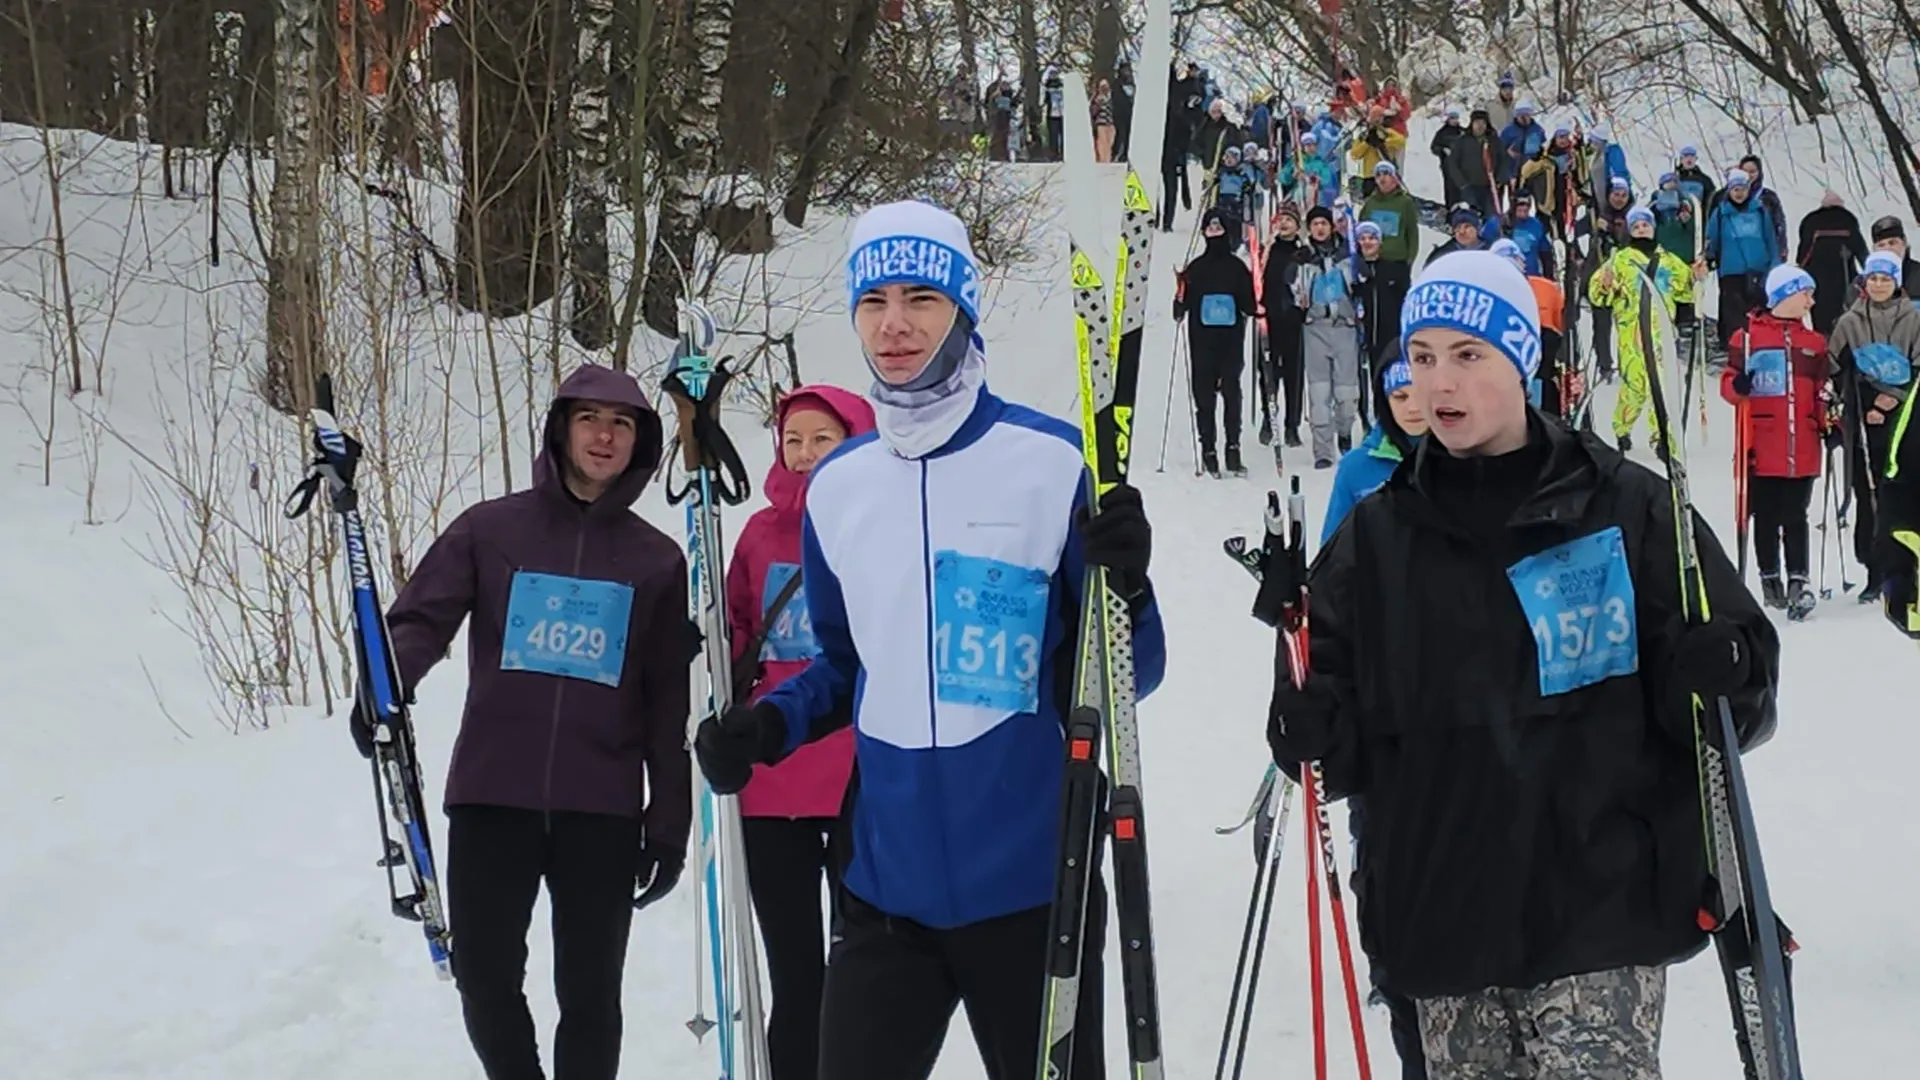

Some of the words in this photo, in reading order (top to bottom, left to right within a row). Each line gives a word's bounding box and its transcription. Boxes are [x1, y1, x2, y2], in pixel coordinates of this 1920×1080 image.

[527, 619, 607, 661] 4629
[936, 620, 1039, 683] 1513
[1532, 596, 1631, 662] 1573
